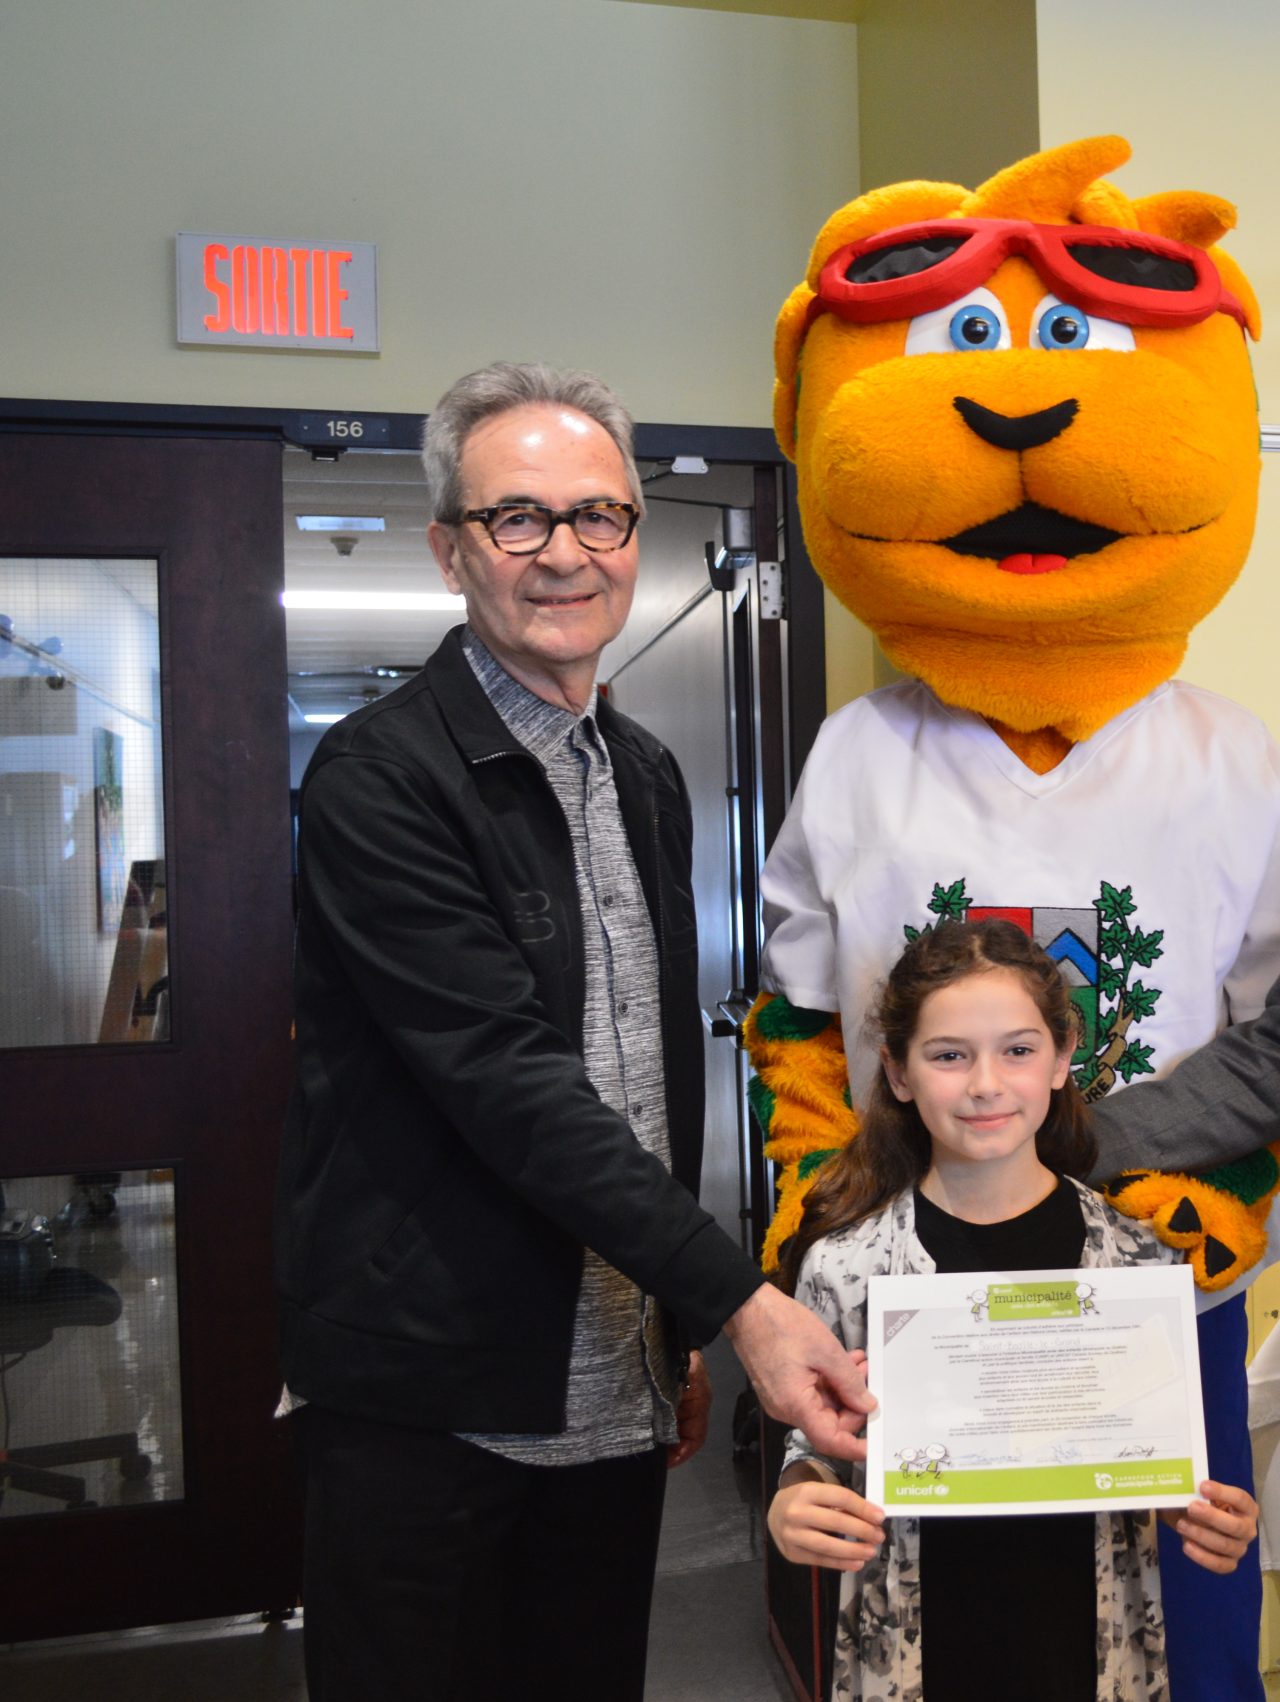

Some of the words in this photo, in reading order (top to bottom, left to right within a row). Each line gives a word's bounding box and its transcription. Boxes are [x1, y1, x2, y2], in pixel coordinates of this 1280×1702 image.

[204, 243, 354, 338] SORTIE
[327, 421, 363, 437] 156
[994, 1291, 1072, 1304] municipalité
[896, 1485, 934, 1496] unicef
